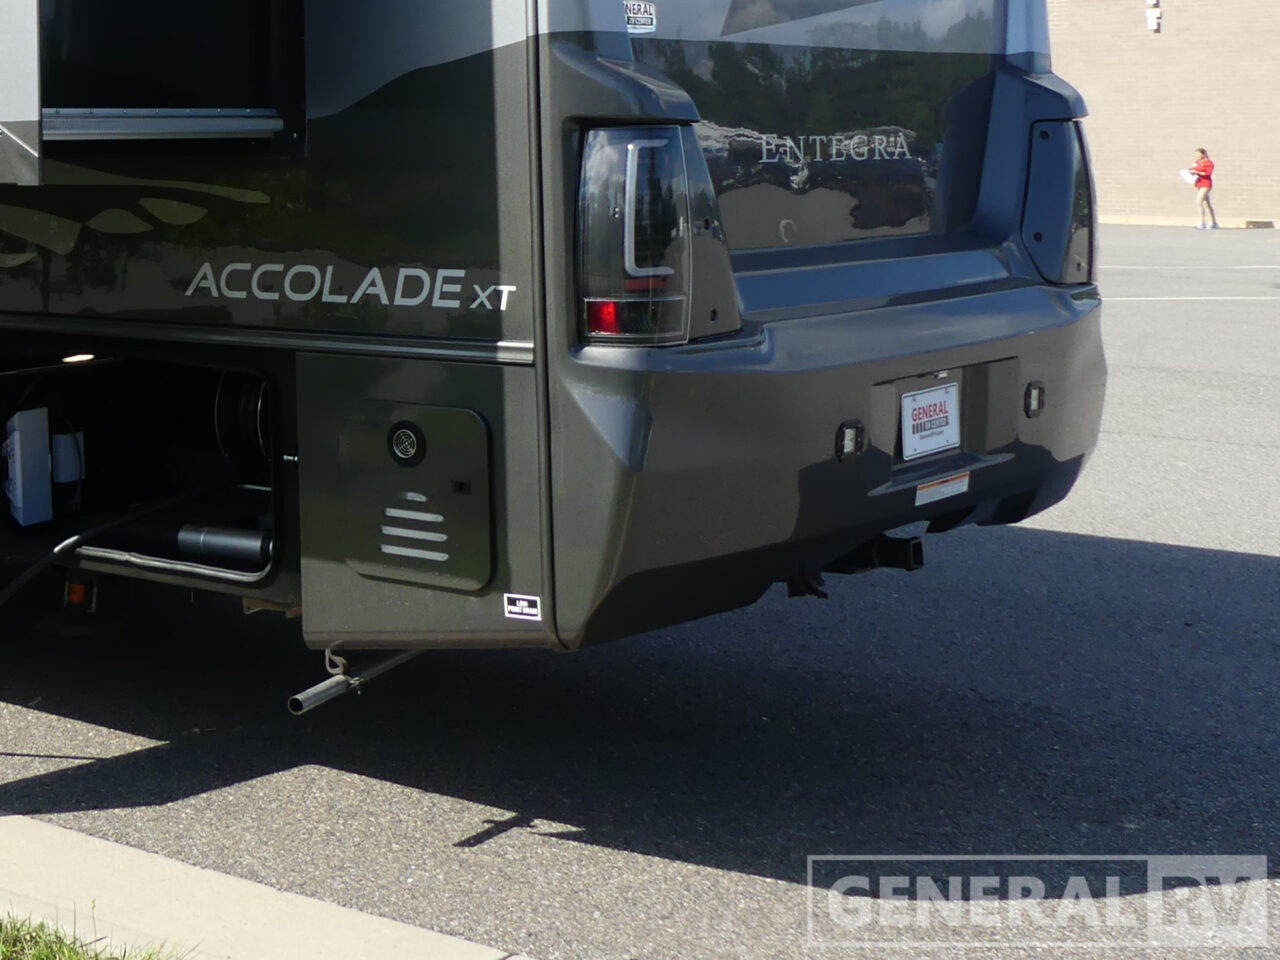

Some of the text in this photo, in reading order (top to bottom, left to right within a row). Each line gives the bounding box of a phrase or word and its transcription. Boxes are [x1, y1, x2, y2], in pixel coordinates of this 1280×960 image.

[625, 3, 654, 16] NERAL
[758, 132, 913, 163] ENTEGRA
[184, 262, 517, 311] ACCOLADE XT
[911, 400, 949, 422] GENERAL
